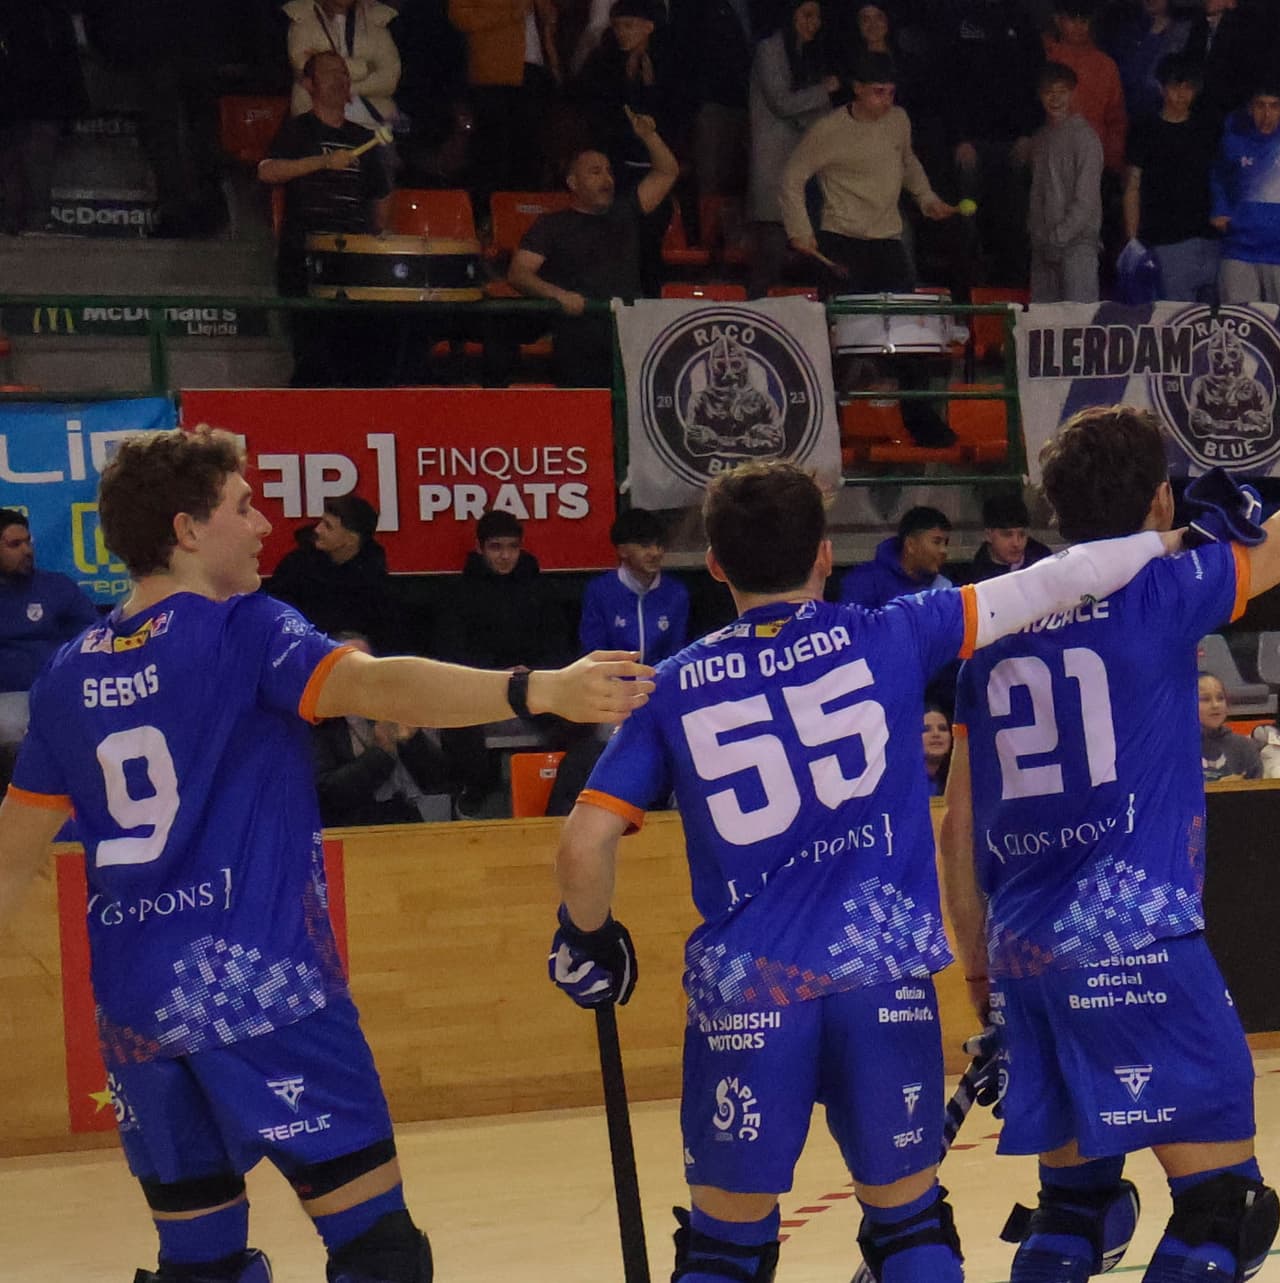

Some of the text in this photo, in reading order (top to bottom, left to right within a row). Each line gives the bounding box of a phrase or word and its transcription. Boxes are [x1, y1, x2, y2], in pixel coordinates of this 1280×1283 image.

[1028, 326, 1193, 377] ILERDAM
[416, 446, 588, 479] FINQUES
[1203, 439, 1257, 459] BLUE
[418, 482, 590, 521] PRATS
[680, 626, 851, 690] NICO OJEDA
[987, 647, 1117, 800] 21
[681, 657, 889, 845] 55
[96, 725, 180, 867] 9
[138, 882, 214, 922] PONS
[1069, 990, 1168, 1009] Bemi-Auto
[1087, 973, 1142, 987] oficial
[708, 1032, 765, 1051] MOTORS
